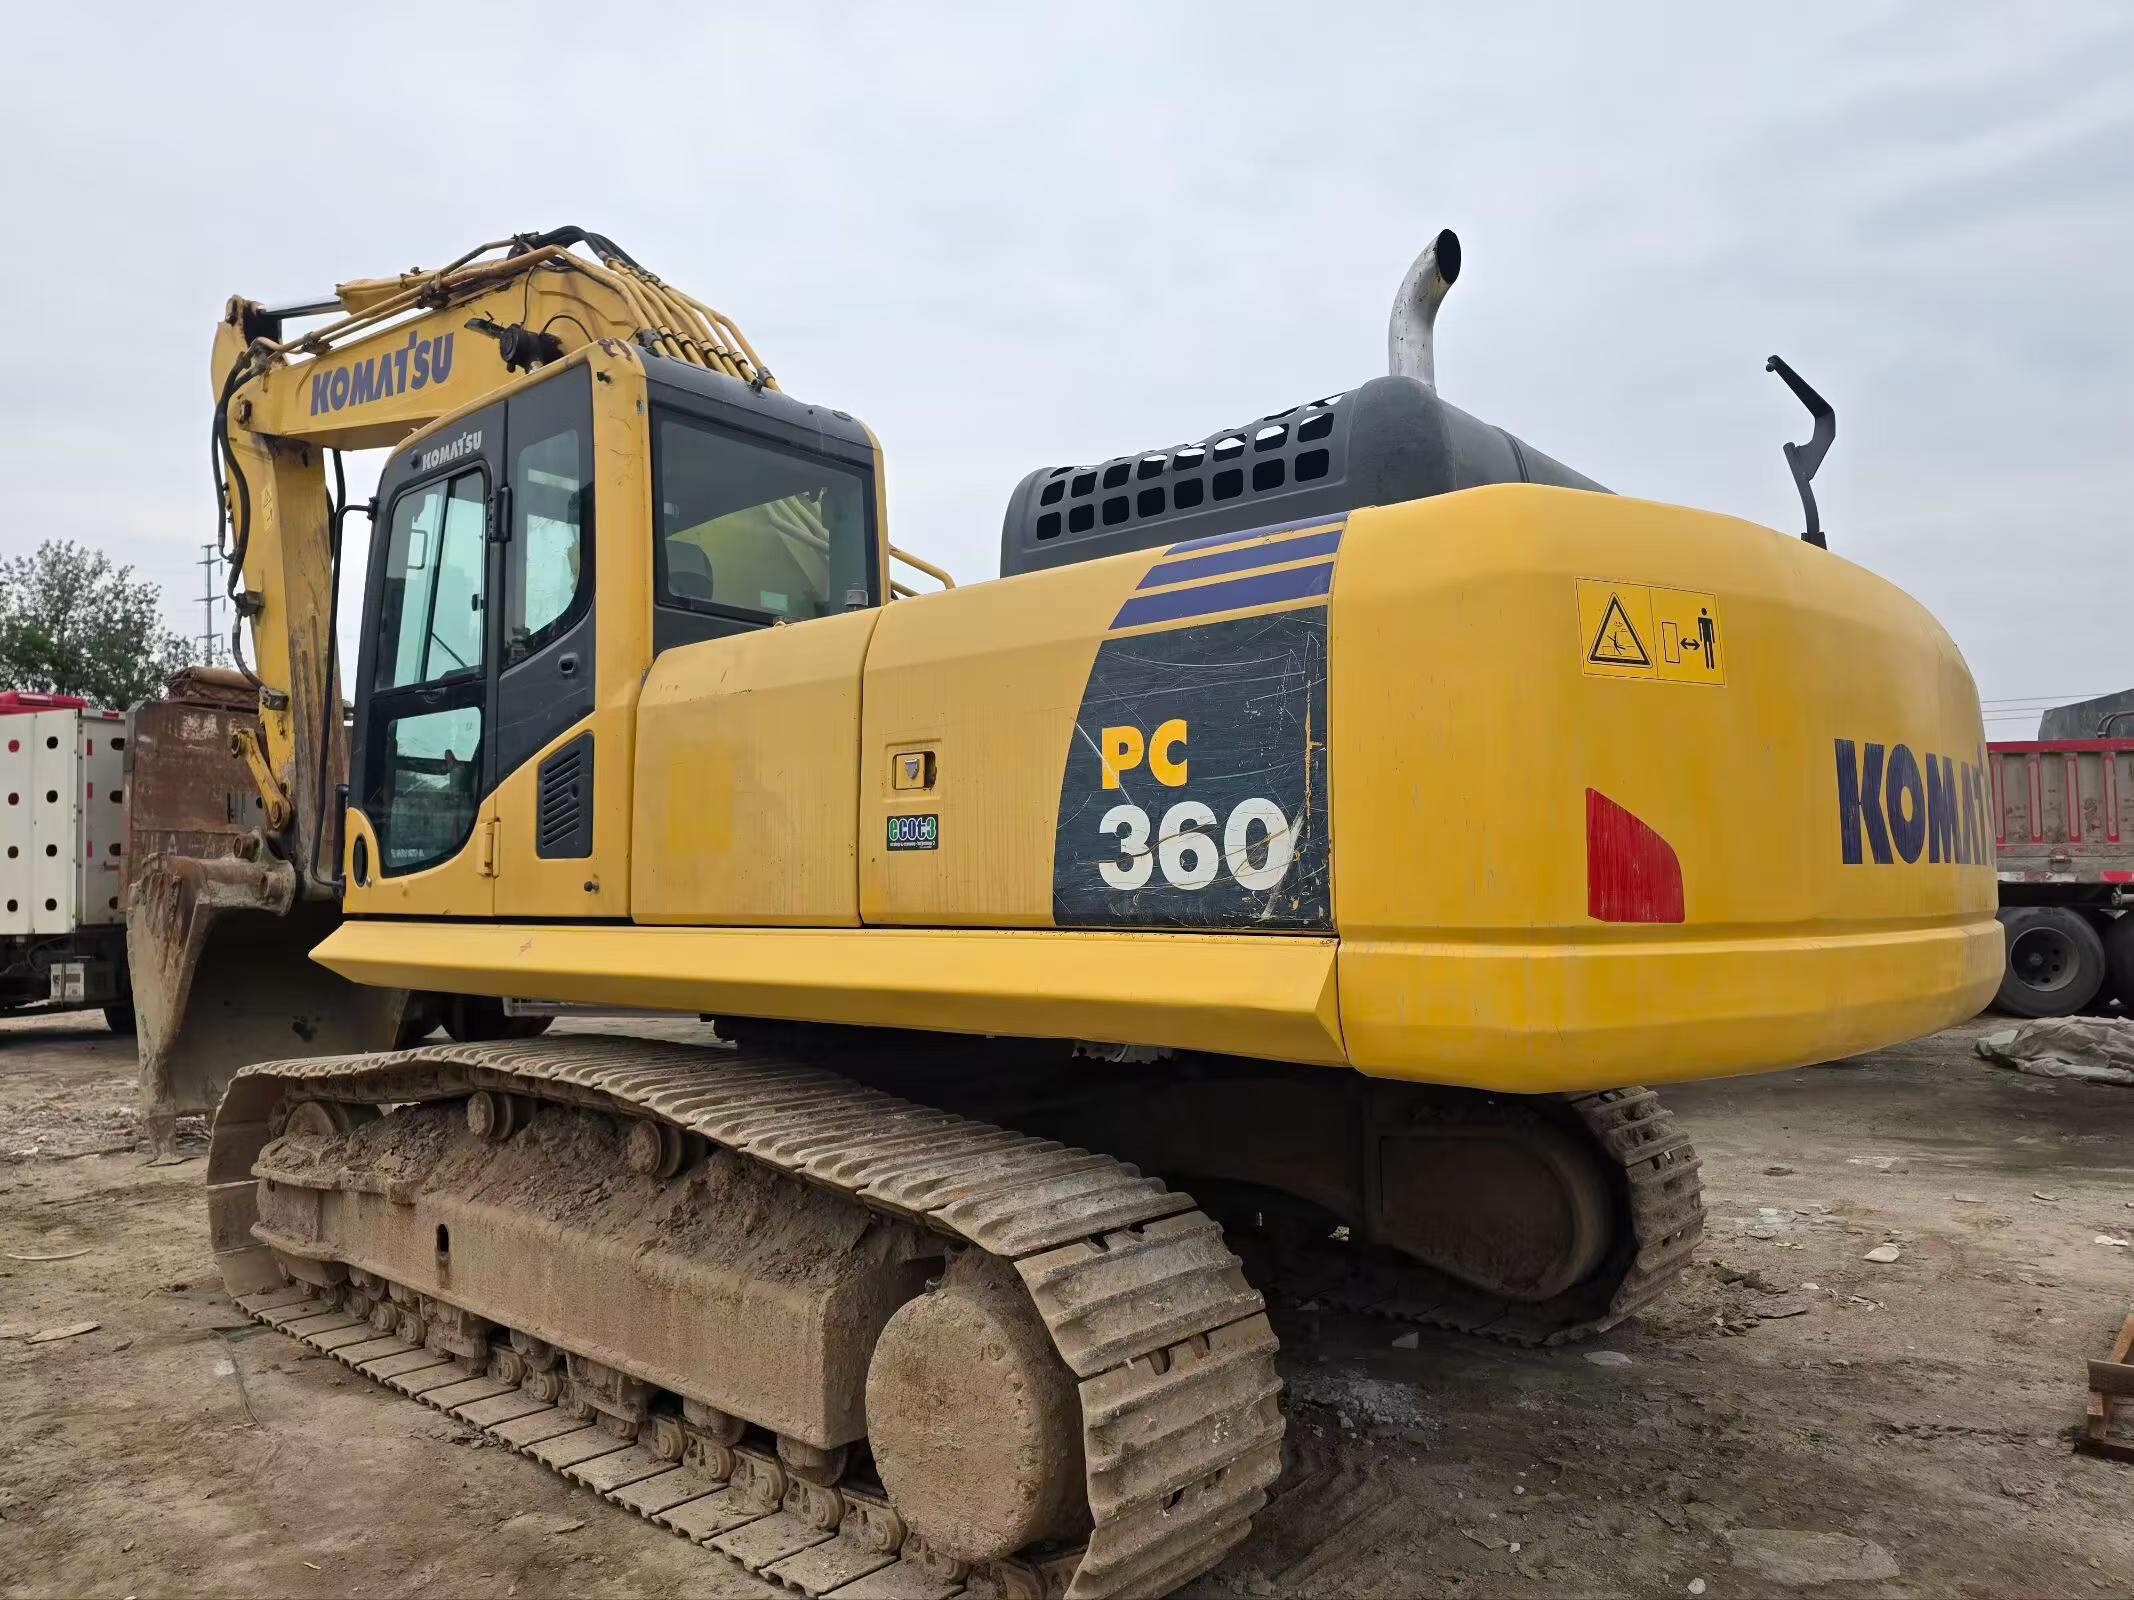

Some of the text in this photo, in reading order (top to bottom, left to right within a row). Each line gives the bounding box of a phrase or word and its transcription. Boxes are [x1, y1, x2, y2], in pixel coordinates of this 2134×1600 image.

[310, 330, 454, 416] KOMATSU
[422, 430, 482, 472] KOMATSU
[1101, 718, 1188, 790] PC
[888, 816, 937, 841] ecot3
[1098, 797, 1291, 891] 360
